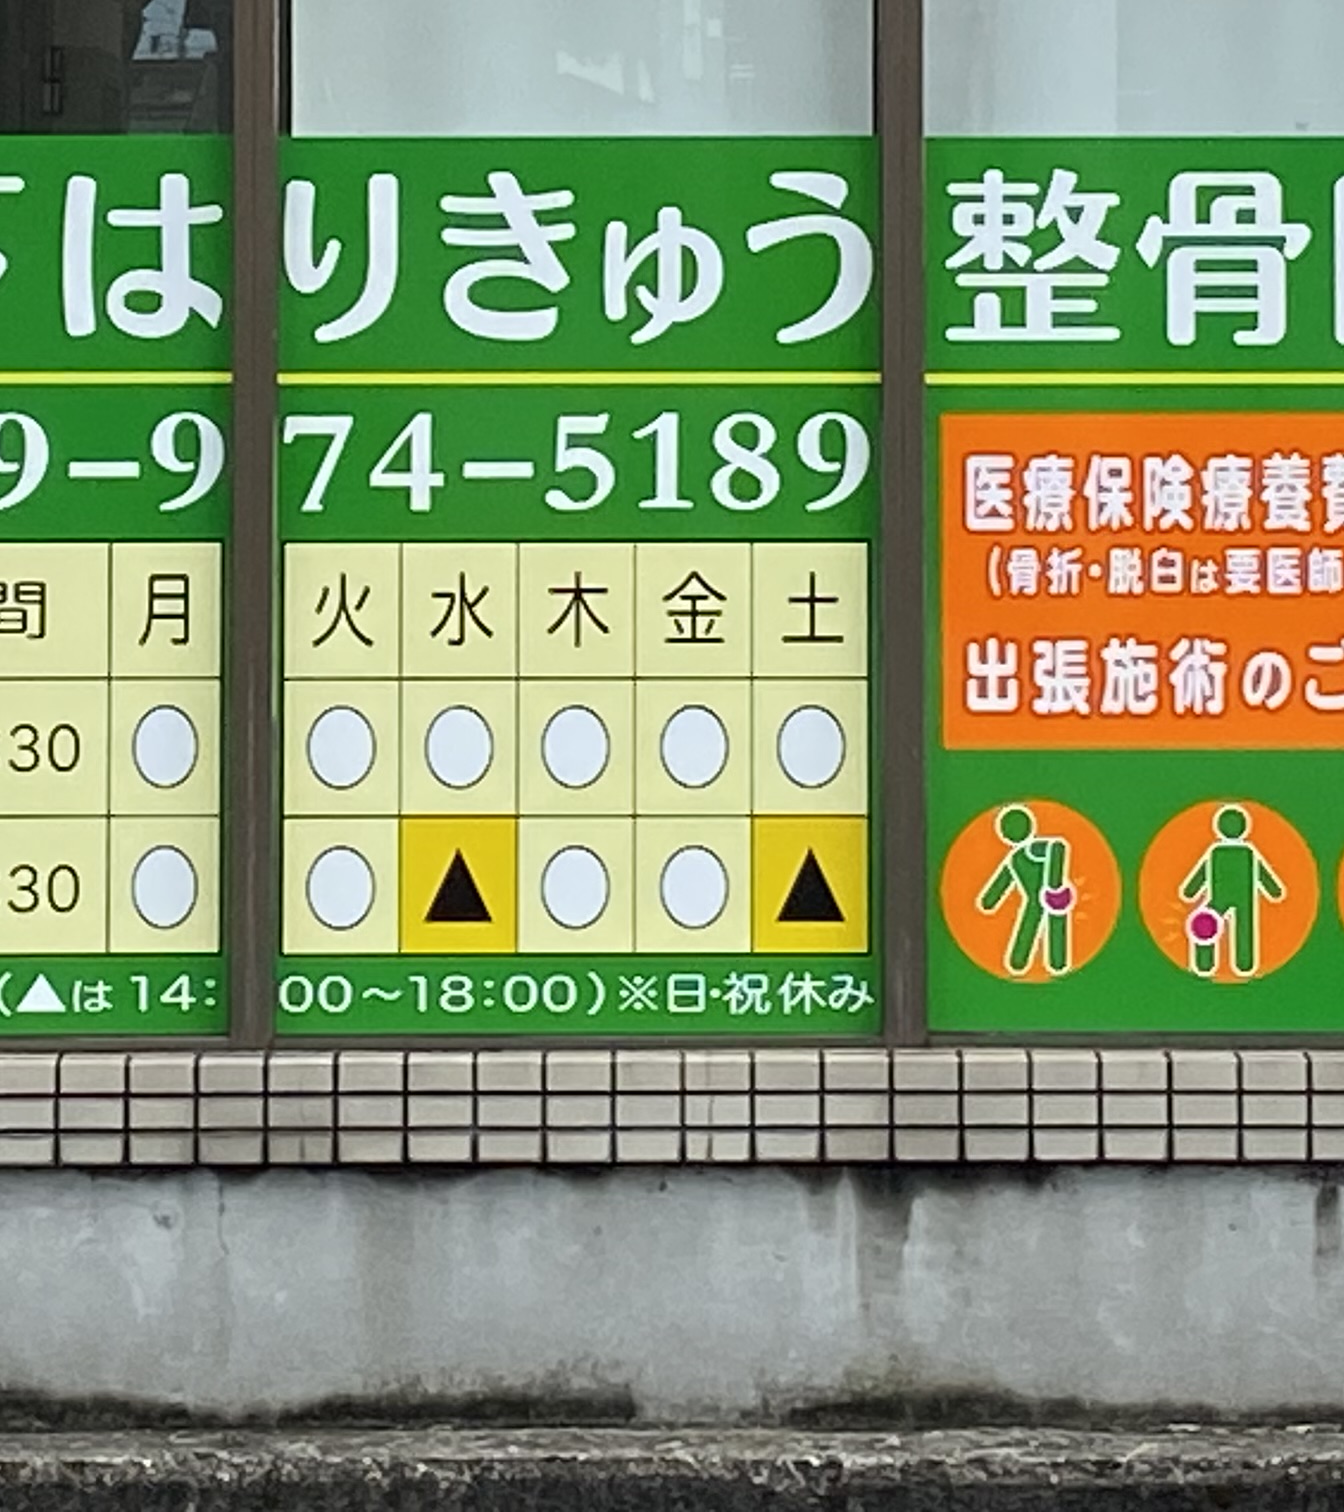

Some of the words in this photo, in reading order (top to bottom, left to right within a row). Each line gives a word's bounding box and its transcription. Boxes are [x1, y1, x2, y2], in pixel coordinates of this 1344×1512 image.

[138, 573, 192, 648] 月
[312, 572, 376, 650] 火
[430, 571, 496, 649] 水
[547, 571, 612, 650] 木
[662, 570, 730, 646] 金
[781, 571, 846, 646] 土
